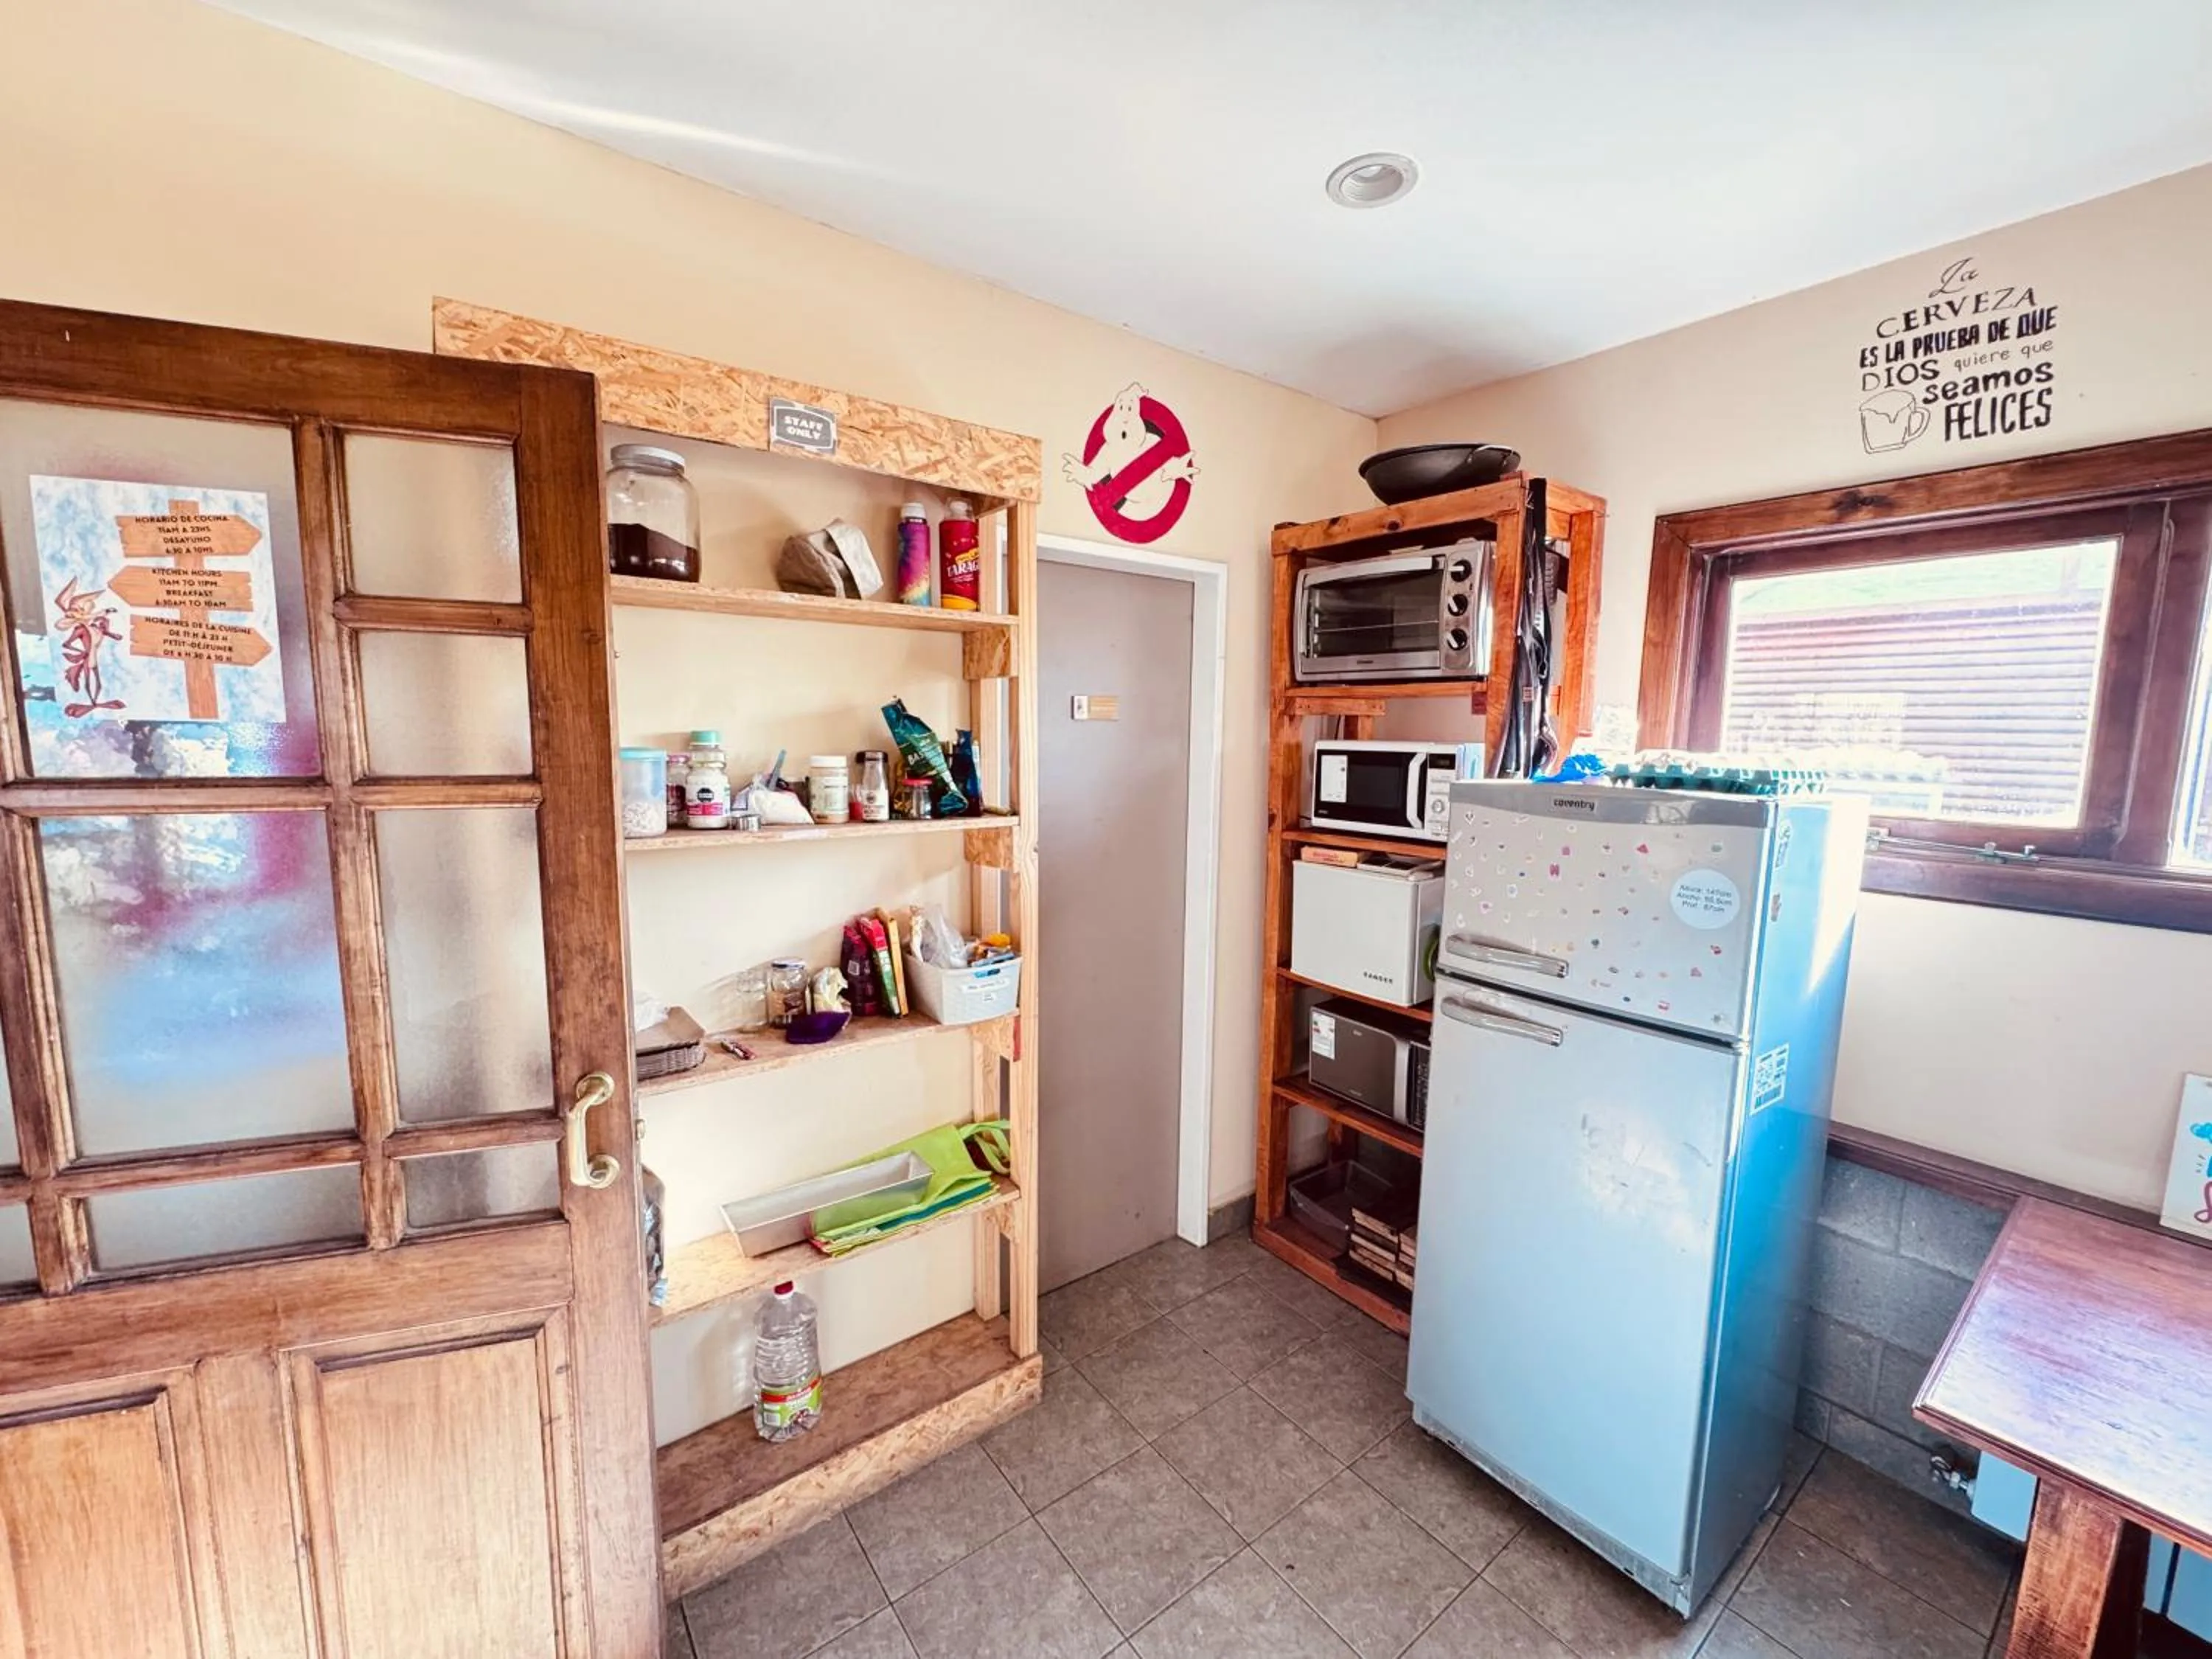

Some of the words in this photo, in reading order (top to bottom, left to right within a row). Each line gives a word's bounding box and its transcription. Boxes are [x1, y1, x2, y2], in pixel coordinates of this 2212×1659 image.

[1928, 257, 1979, 298] La
[1877, 287, 2038, 338] CERVEZA
[1860, 346, 1878, 368] ES
[1885, 340, 1905, 363] LA
[1912, 324, 1980, 359] PRUEBA
[1988, 317, 2011, 344] DE
[2016, 305, 2059, 338] QUE
[1862, 358, 1940, 392] DIOS
[1954, 349, 2011, 372] quiere
[2020, 339, 2054, 359] que
[1922, 361, 2054, 405] seamos
[784, 416, 824, 431] STAFF
[1944, 386, 2053, 442] FELICES
[786, 426, 821, 440] ONLY
[135, 515, 178, 524] HORARIO
[166, 589, 212, 597] BREAKFAST
[145, 616, 189, 627] HORAIRES
[218, 625, 251, 635] CUISINE
[1554, 799, 1595, 812] coventry
